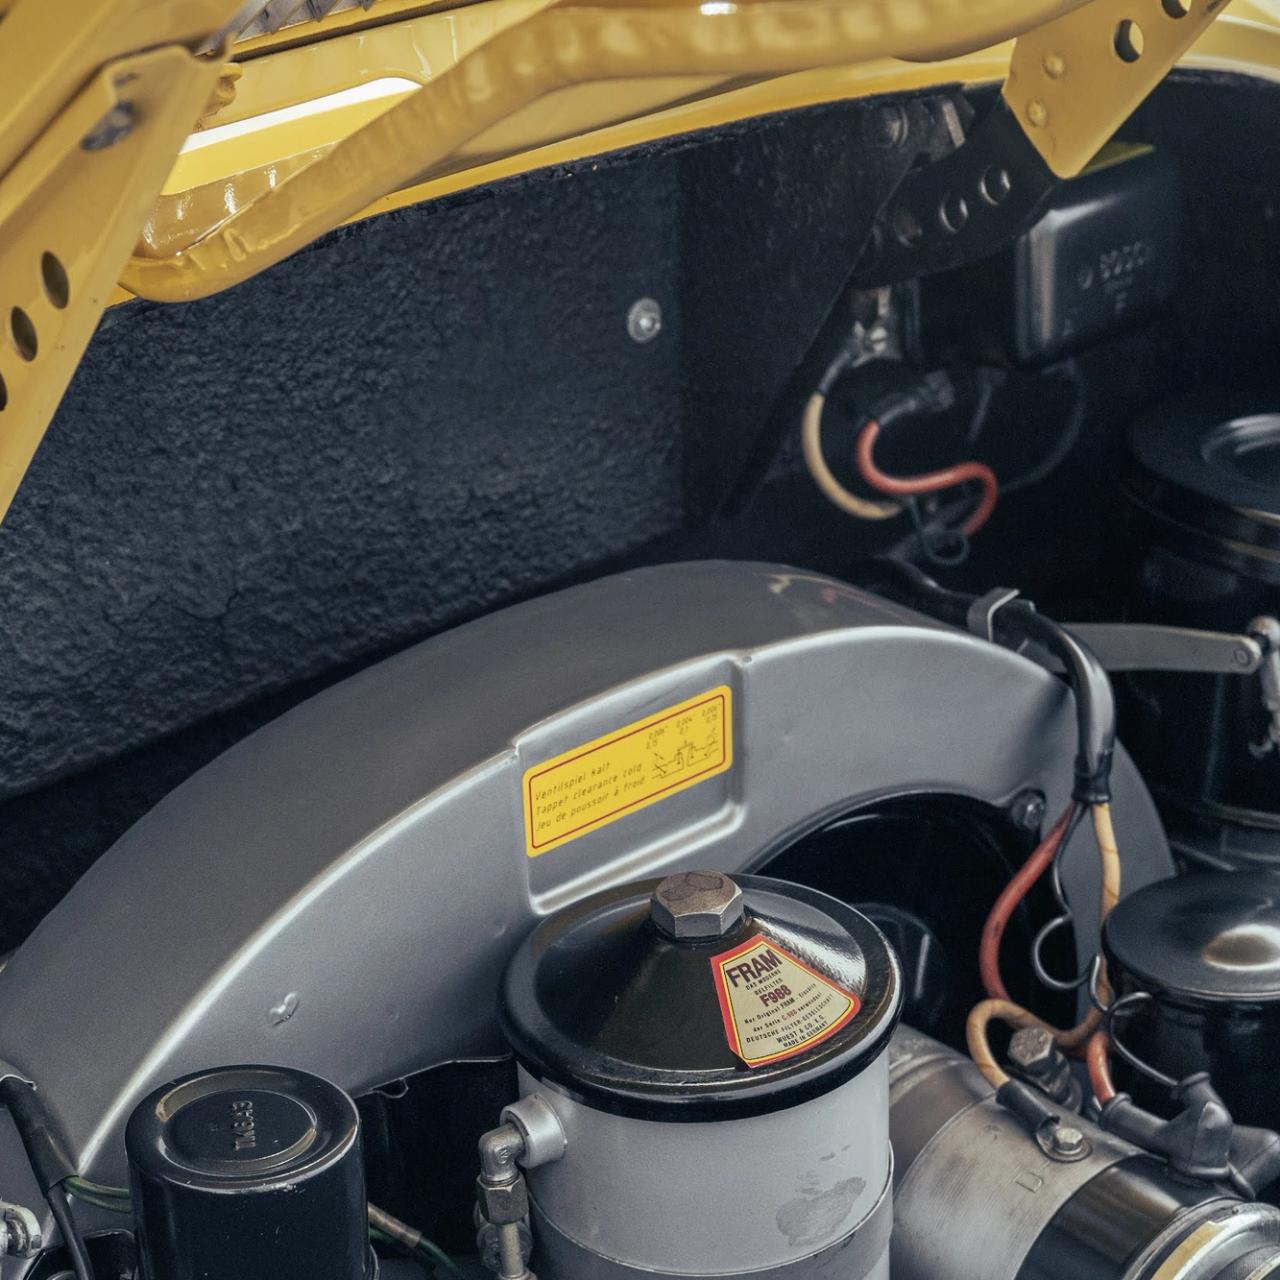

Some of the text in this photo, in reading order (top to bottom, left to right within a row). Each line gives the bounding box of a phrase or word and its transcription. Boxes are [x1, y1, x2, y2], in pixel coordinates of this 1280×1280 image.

[537, 797, 569, 815] Tappet
[573, 775, 618, 799] clearance
[556, 812, 566, 823] de
[726, 949, 783, 987] FRAM
[746, 982, 757, 990] DAS
[760, 985, 792, 1007] F988
[783, 1038, 799, 1047] MADE
